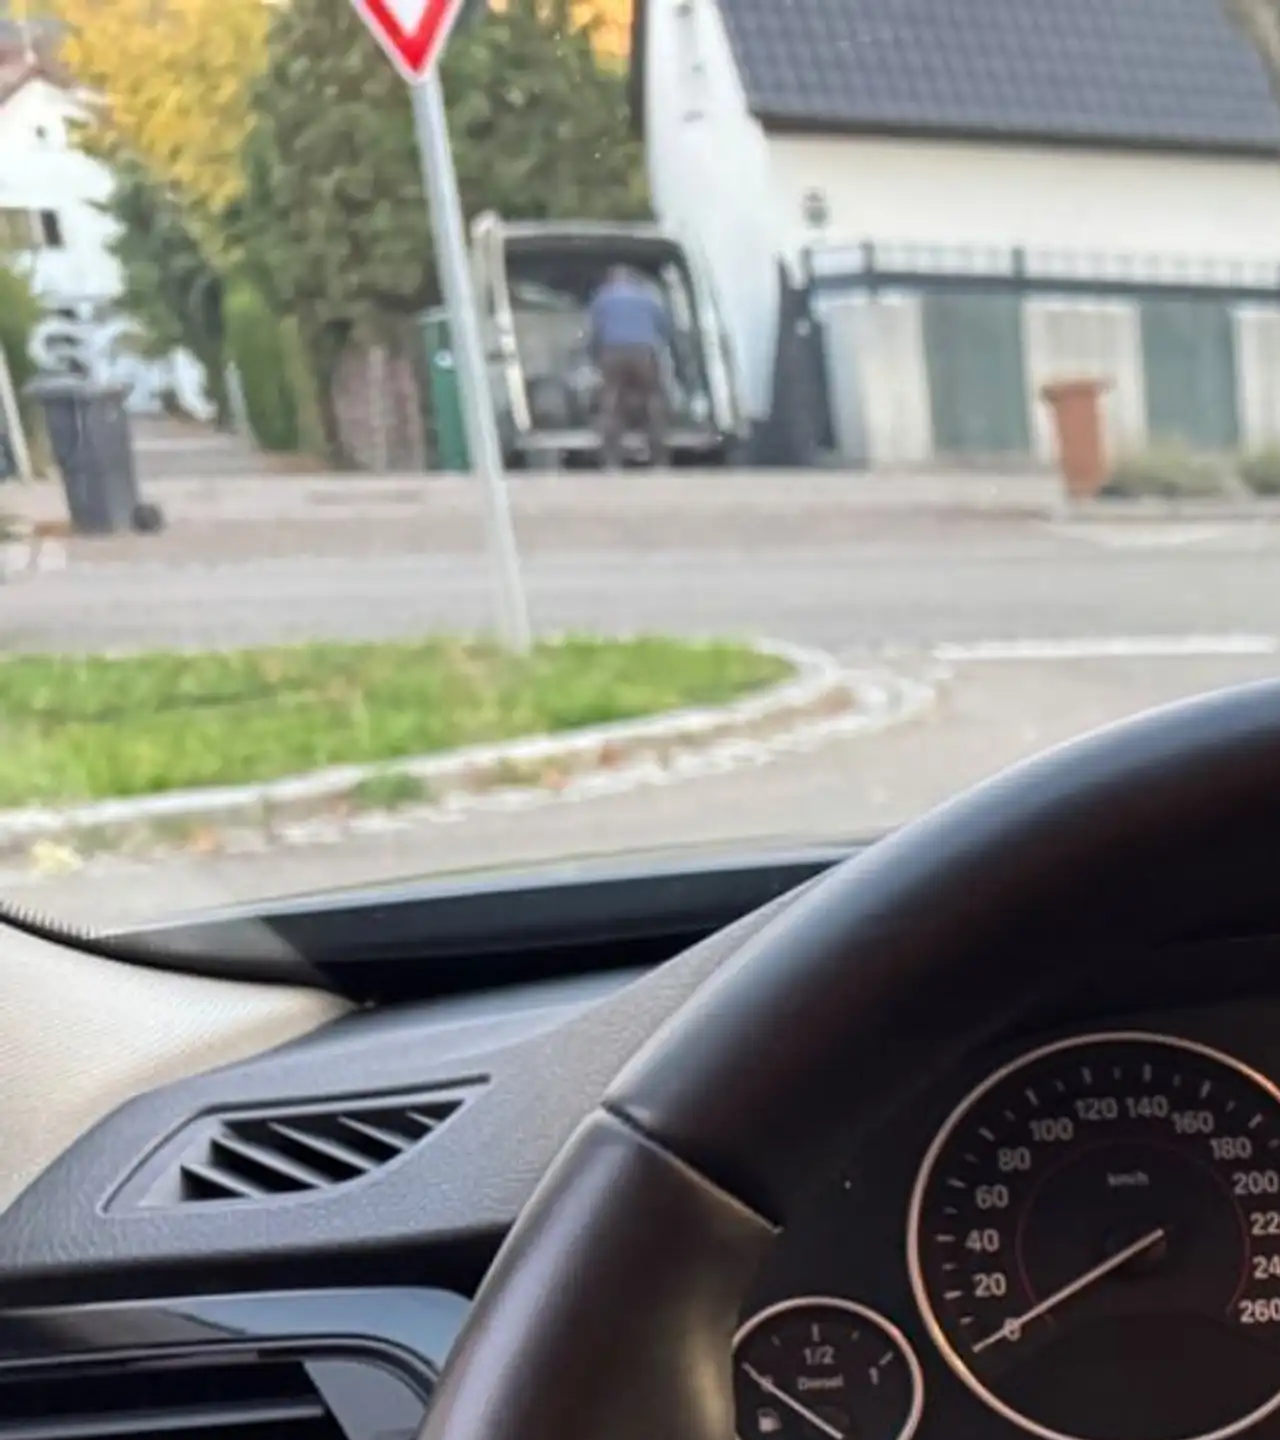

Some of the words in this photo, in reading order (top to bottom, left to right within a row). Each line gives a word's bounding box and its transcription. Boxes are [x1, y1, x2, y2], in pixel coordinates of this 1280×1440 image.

[1075, 1097, 1118, 1121] 120
[1125, 1095, 1170, 1119] 140
[1029, 1117, 1074, 1142] 100
[1172, 1110, 1215, 1135] 160
[998, 1147, 1031, 1172] 80
[1210, 1136, 1253, 1161] 180
[1232, 1170, 1279, 1195] 200
[975, 1184, 1010, 1209] 60
[965, 1227, 1000, 1252] 40
[972, 1273, 1007, 1299] 20
[803, 1345, 836, 1366] 1/2
[868, 1366, 879, 1386] 1
